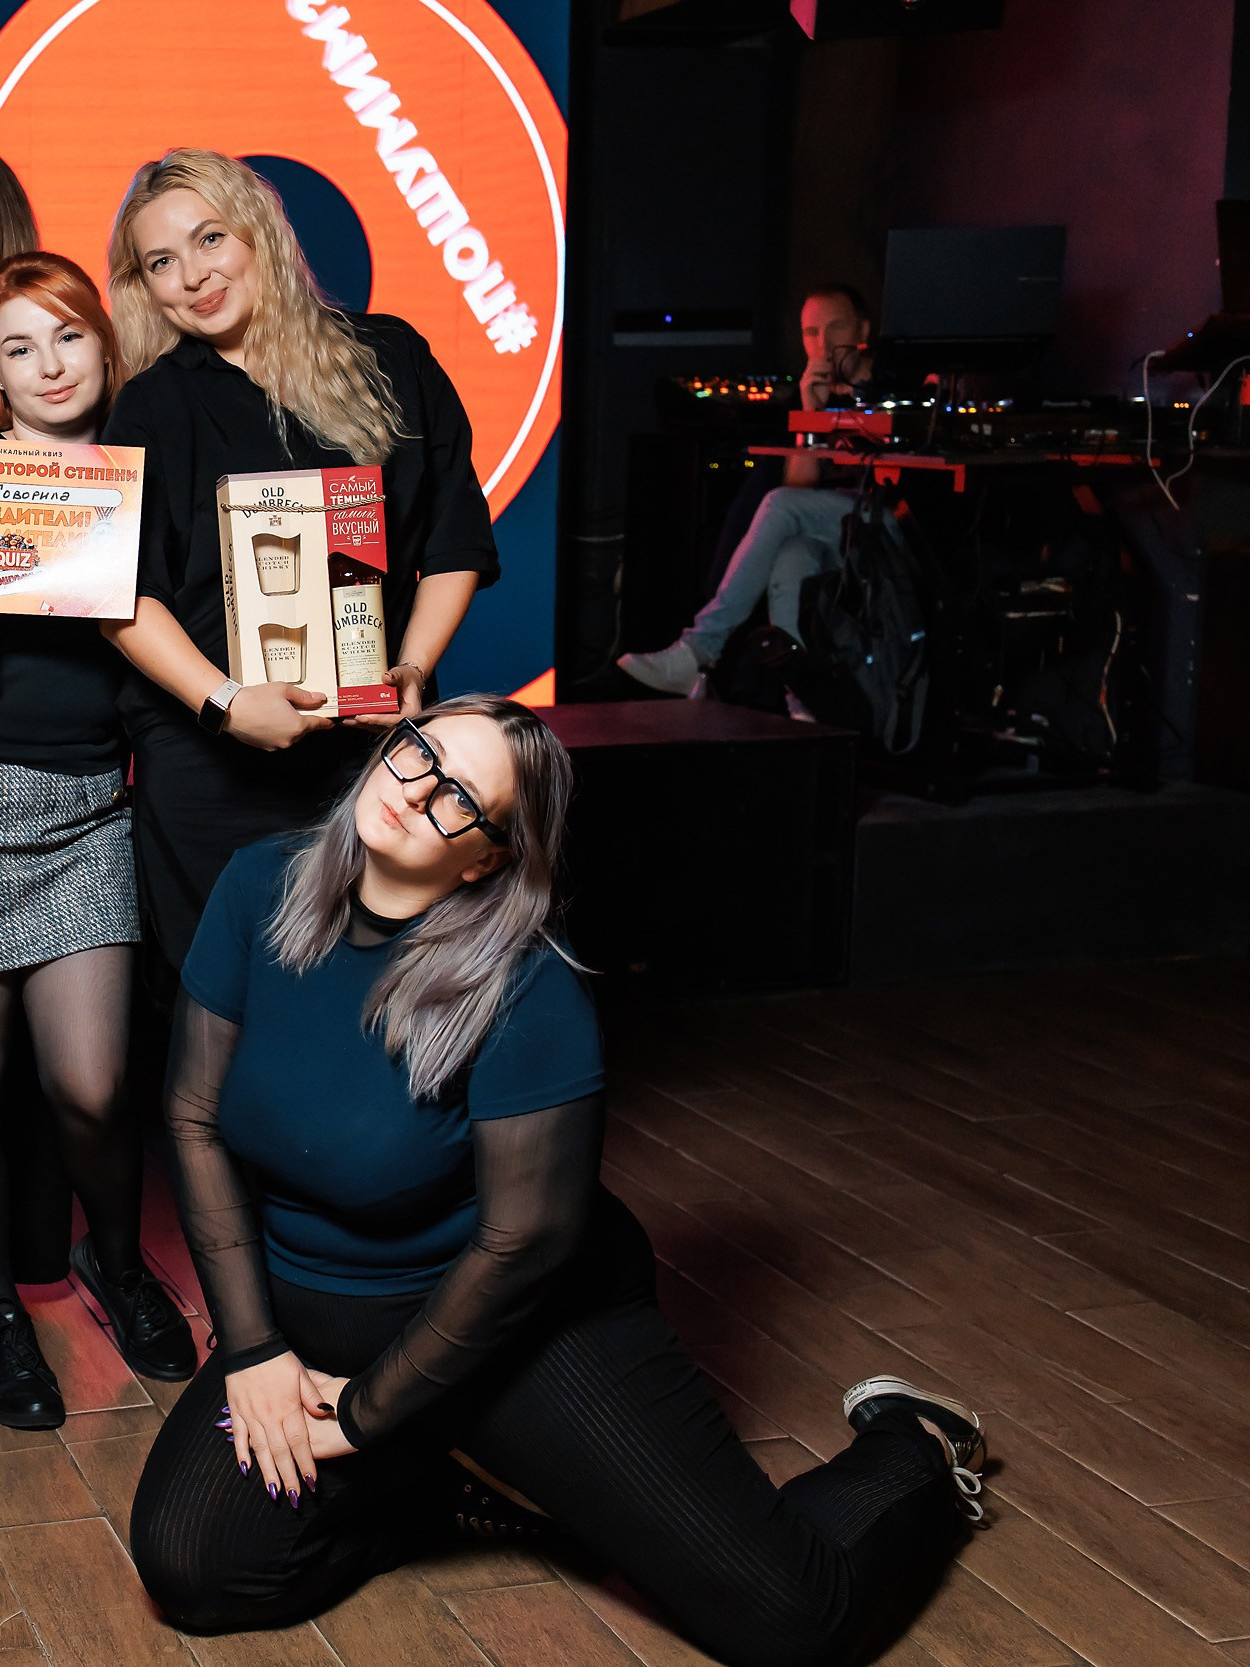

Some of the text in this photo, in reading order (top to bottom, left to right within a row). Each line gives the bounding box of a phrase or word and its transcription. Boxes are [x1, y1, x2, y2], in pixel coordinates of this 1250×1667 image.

[64, 466, 138, 482] СТЕПЕНИ
[261, 486, 285, 498] OLD
[329, 479, 376, 494] САМЫЙ
[333, 509, 376, 521] самый
[332, 518, 379, 536] ВКУСНЫЙ
[344, 602, 367, 614] OLD
[334, 614, 383, 631] UMBRECK
